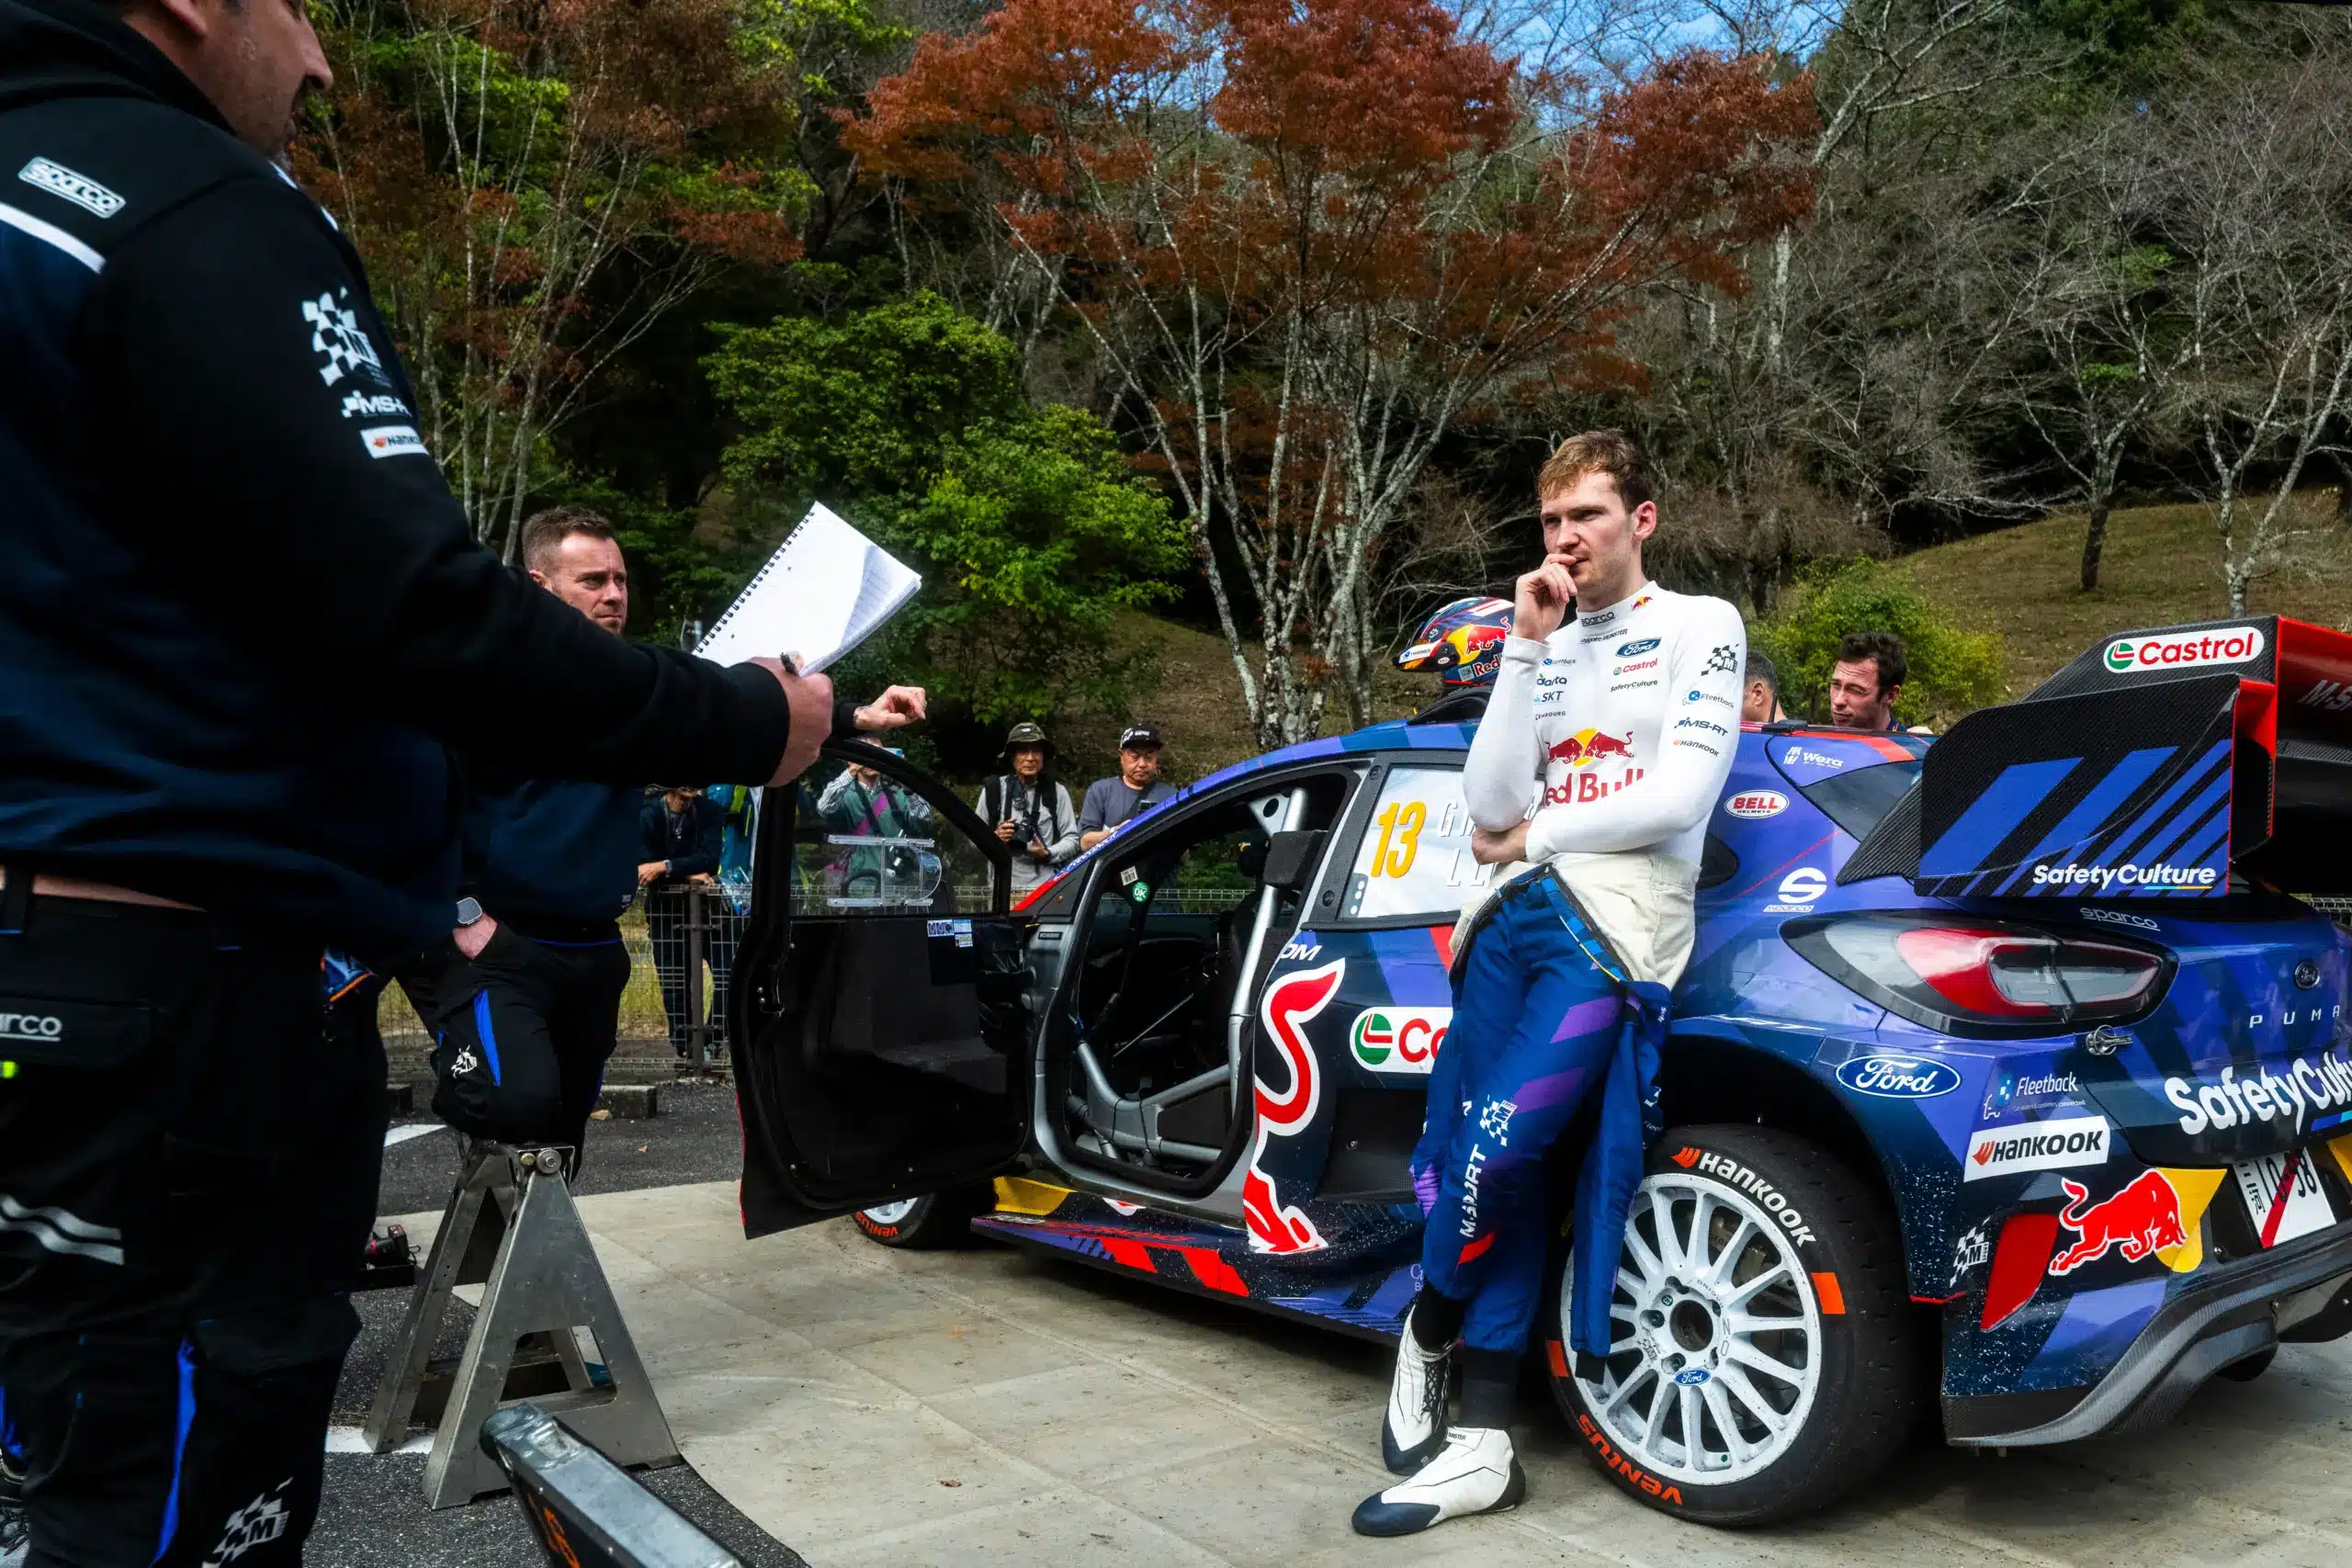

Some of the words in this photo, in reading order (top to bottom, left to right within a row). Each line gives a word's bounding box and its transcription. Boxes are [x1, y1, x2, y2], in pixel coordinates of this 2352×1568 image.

[1623, 641, 1656, 656] Ford
[2138, 632, 2255, 666] Castrol
[1623, 658, 1658, 673] Castrol
[1610, 680, 1658, 693] SafetyCulture
[1541, 691, 1564, 703] SKT
[1700, 693, 1735, 709] Fleetback
[1803, 752, 1844, 767] Wera
[1544, 773, 1573, 807] ed
[1733, 796, 1779, 810] BELL
[1371, 800, 1427, 879] 13
[2032, 863, 2216, 891] SafetyCulture
[2079, 906, 2160, 931] sparco
[2248, 1004, 2341, 1029] PUMA
[1855, 1058, 1939, 1093] Ford
[2016, 1071, 2079, 1098] Fleetback
[1680, 1371, 1703, 1384] Ford
